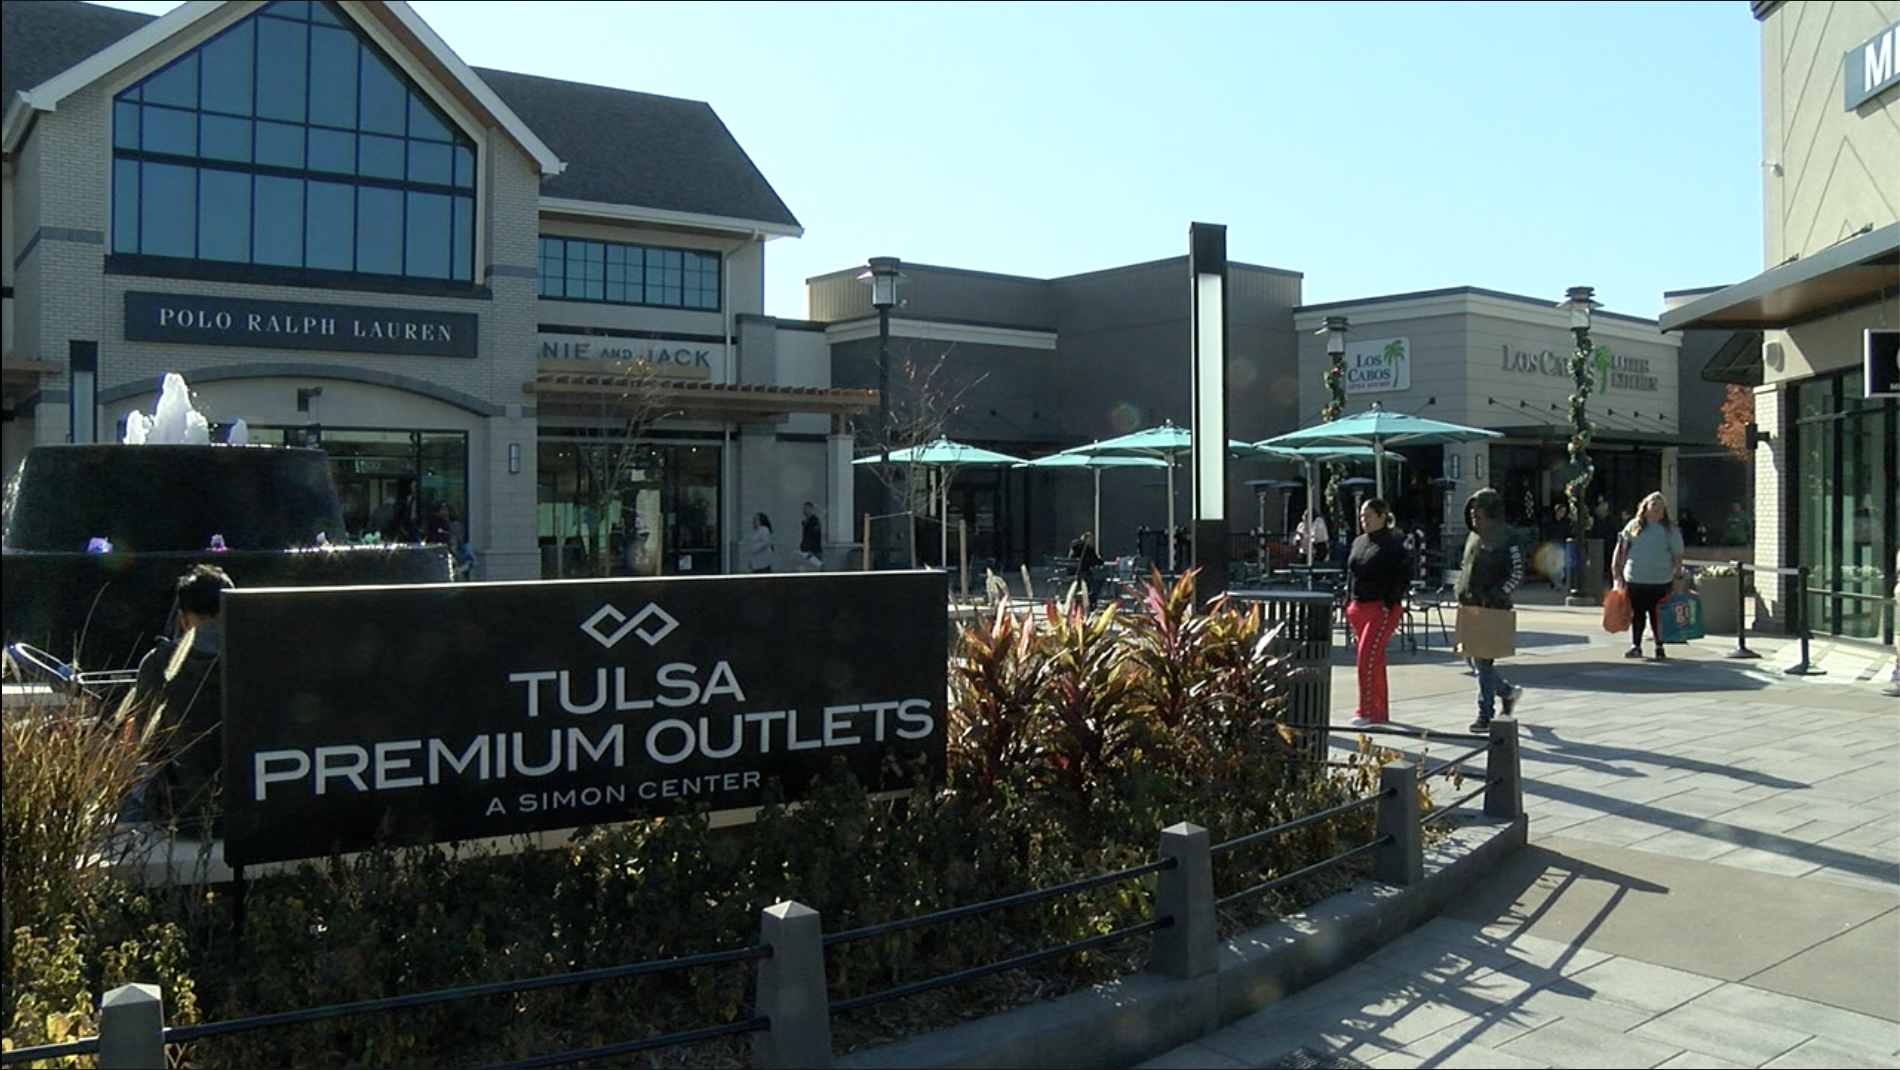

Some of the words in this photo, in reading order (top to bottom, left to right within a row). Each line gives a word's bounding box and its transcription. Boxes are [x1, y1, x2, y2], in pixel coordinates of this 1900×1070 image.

[159, 308, 232, 330] POLO
[248, 313, 336, 335] RALPH
[353, 320, 452, 342] LAUREN
[538, 341, 590, 359] NIE
[601, 347, 633, 360] AND
[1356, 354, 1382, 368] LOS
[1347, 368, 1391, 383] CABOS
[509, 660, 746, 719] TULSA
[254, 723, 625, 802] PREMIUM
[645, 698, 935, 765] OUTLETS
[486, 797, 506, 817] A
[519, 783, 627, 814] SIMON
[638, 771, 762, 802] CENTER
